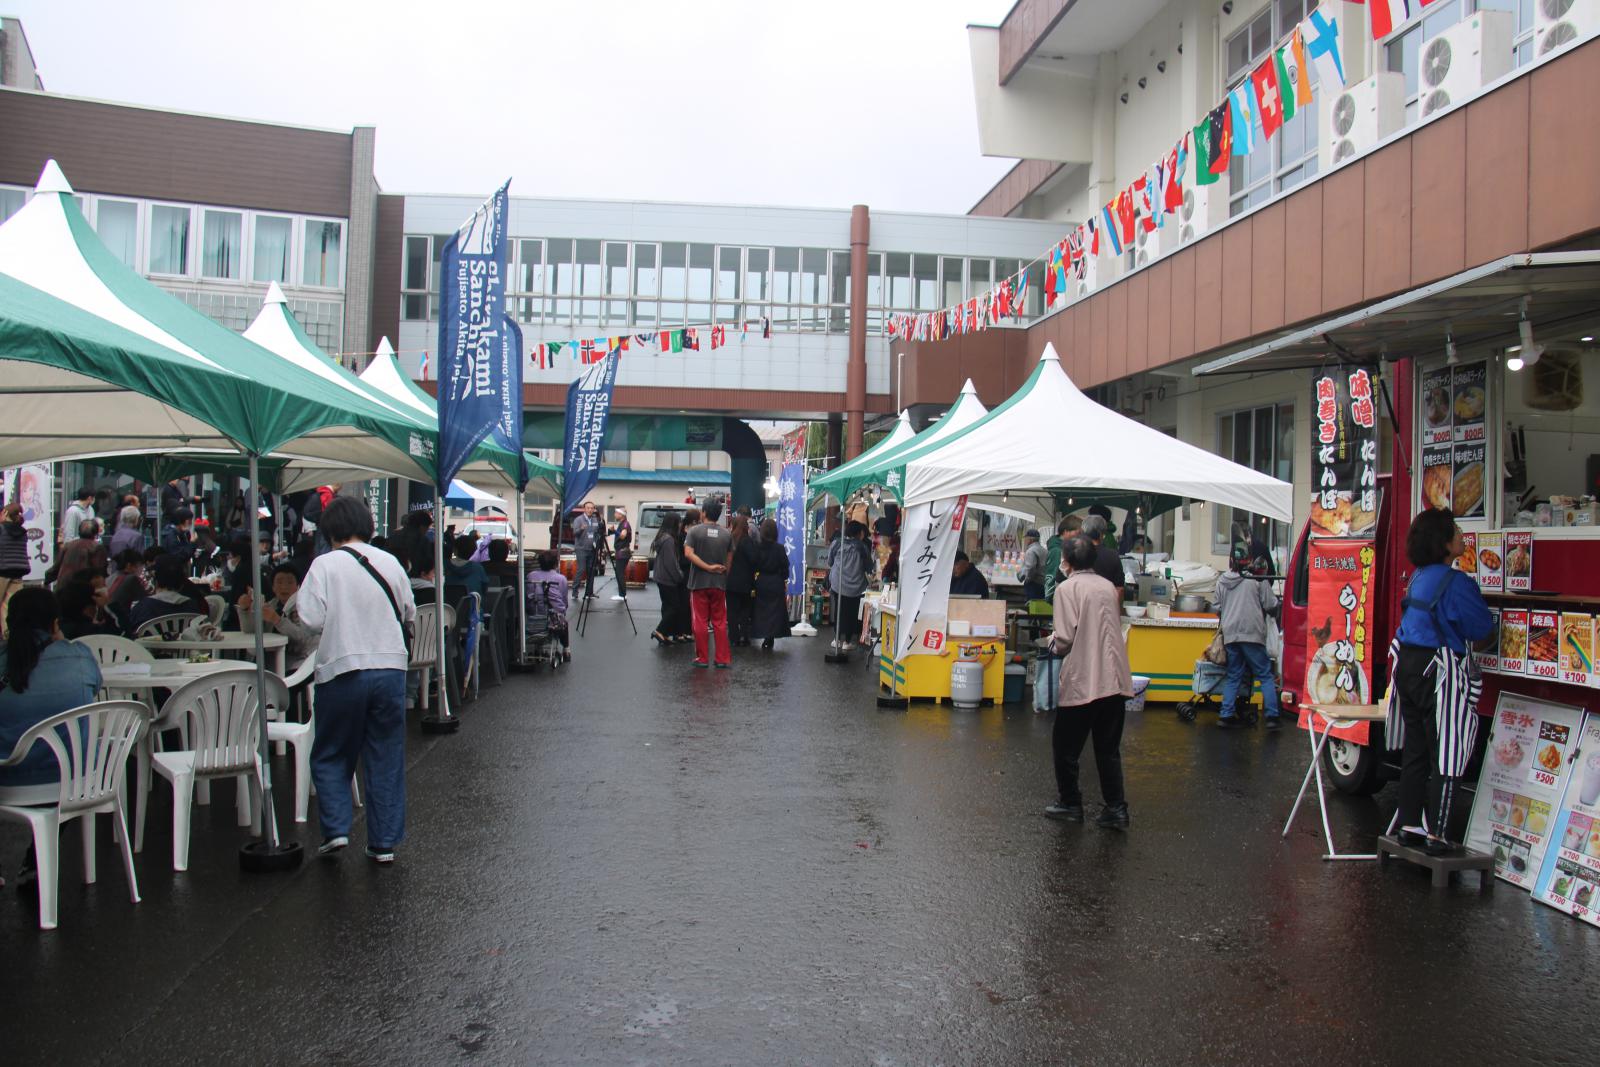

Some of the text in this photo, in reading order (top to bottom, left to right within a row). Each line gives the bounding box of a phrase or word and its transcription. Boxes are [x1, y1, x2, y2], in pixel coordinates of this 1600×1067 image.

[457, 260, 470, 317] Fujisato,
[466, 260, 487, 350] Sanchi
[455, 320, 469, 360] Akita,
[574, 393, 584, 427] Fujisato,
[580, 393, 597, 443] Sanchi
[587, 393, 608, 471] Shirakami
[1481, 576, 1500, 586] ¥500
[1334, 584, 1357, 692] らーめん
[1532, 615, 1554, 627] 焼鳥
[1503, 659, 1522, 670] ¥600
[1533, 664, 1556, 676] ¥600
[1564, 671, 1586, 683] ¥700
[1535, 771, 1555, 786] ¥500
